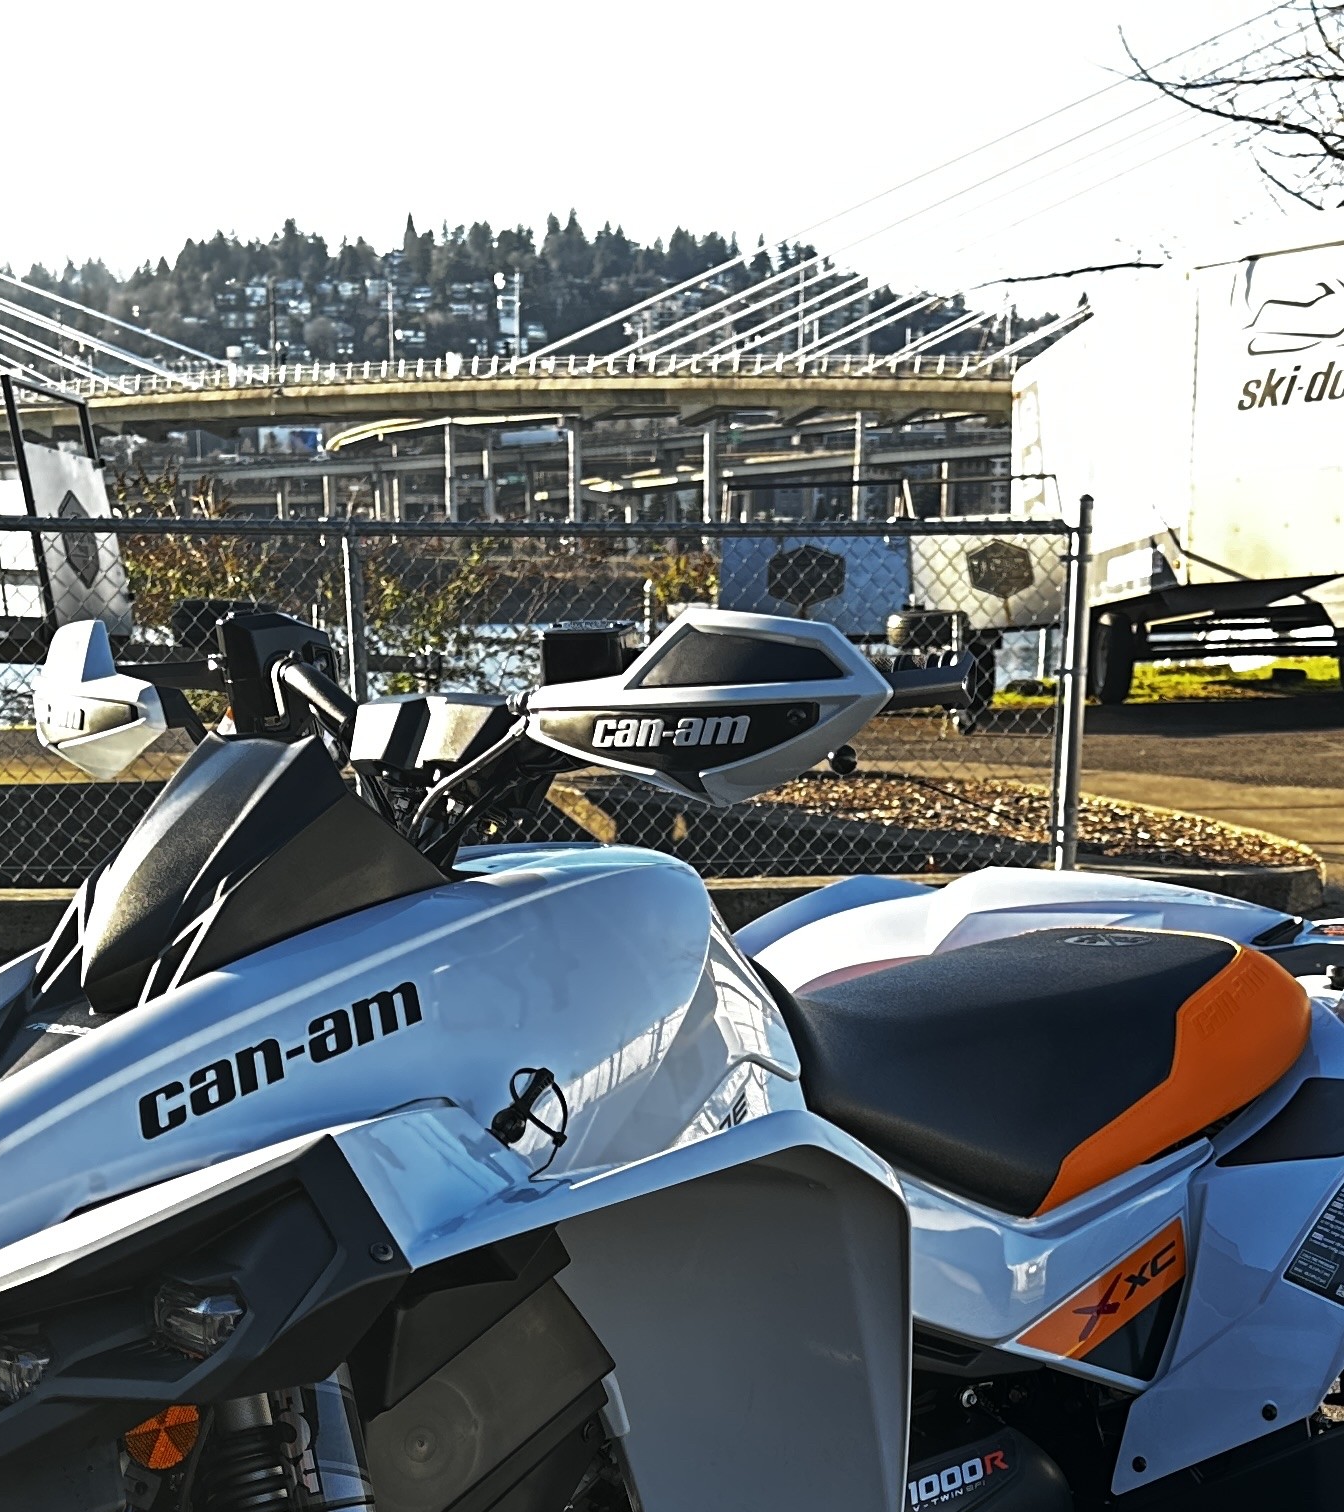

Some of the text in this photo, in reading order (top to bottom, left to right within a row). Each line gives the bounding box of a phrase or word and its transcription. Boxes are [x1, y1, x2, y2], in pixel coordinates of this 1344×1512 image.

[591, 714, 751, 749] can-am
[138, 981, 423, 1141] can-am
[908, 1449, 1009, 1506] 1000R
